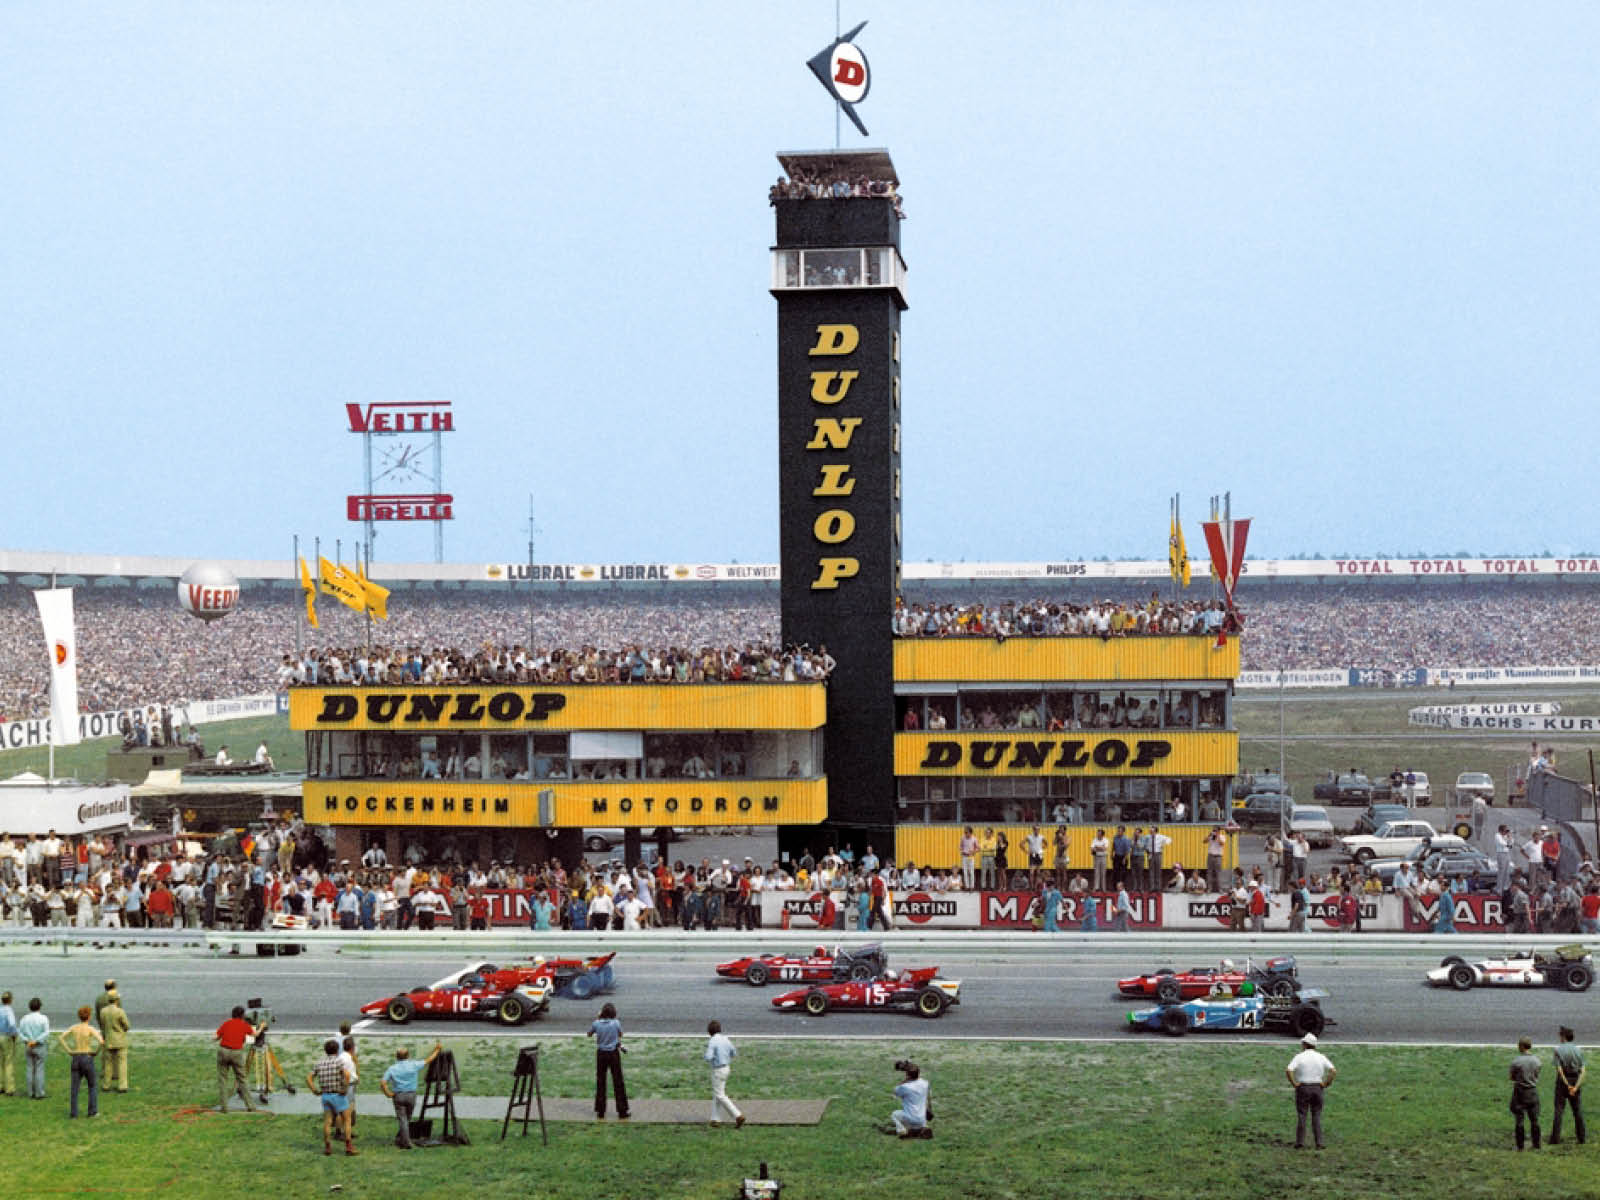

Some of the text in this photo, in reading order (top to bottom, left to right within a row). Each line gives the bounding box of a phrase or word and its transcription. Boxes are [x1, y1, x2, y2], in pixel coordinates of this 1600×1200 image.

[834, 58, 865, 86] D
[345, 401, 452, 431] VEITH
[806, 323, 863, 590] DUNLOP
[347, 493, 453, 521] PIRELLI
[507, 565, 669, 579] LUBRAL LUBRAL
[1047, 564, 1086, 575] PHILIPS
[1336, 561, 1392, 573] TOTAL
[1410, 561, 1466, 573] TOTAL
[1483, 560, 1539, 572] TOTAL
[316, 692, 567, 722] DUNLOP
[921, 739, 1172, 768] DUNLOP
[326, 796, 780, 814] HOCKENHEIM MOTODROM
[893, 903, 953, 914] ARTINI
[452, 994, 473, 1012] 10
[866, 984, 886, 1005] 15
[1241, 1011, 1255, 1027] 14
